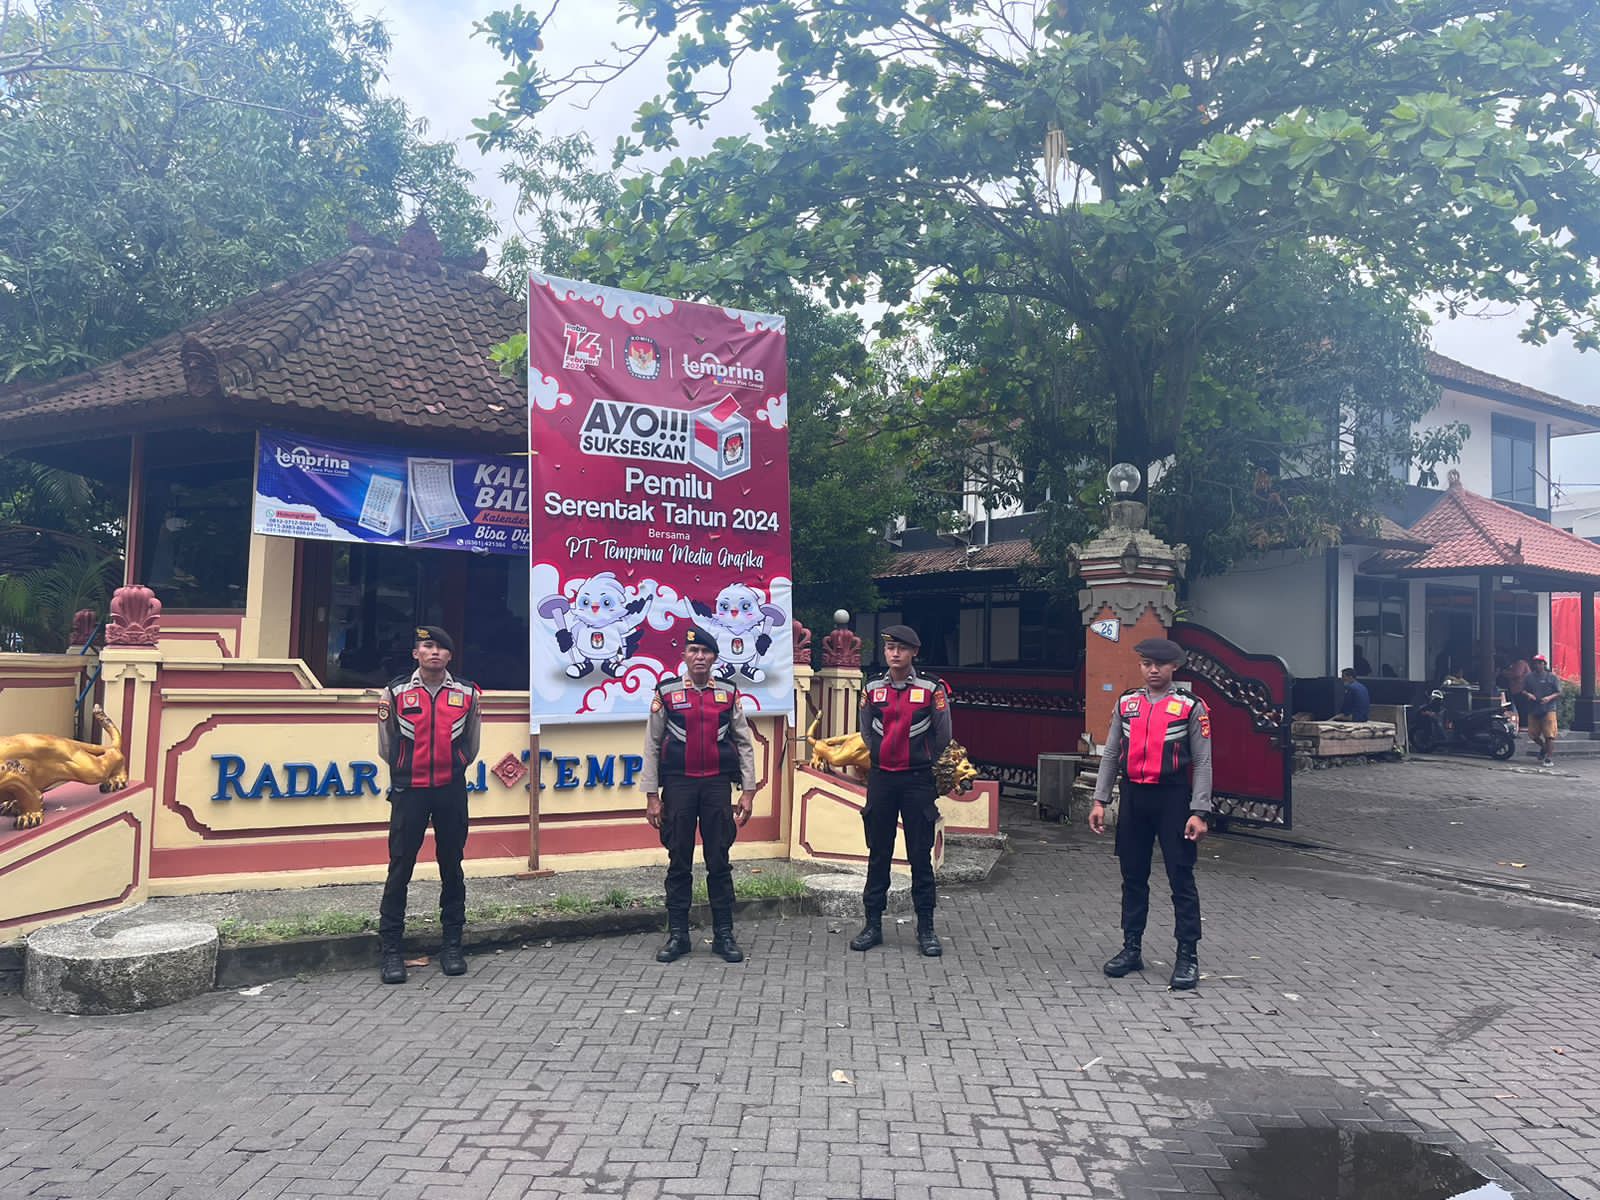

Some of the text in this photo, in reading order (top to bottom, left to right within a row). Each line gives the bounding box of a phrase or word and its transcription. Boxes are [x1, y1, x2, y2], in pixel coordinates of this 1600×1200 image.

[566, 331, 600, 358] 14
[584, 402, 688, 443] AYO!!!
[583, 435, 685, 461] SUKSESKAN
[626, 467, 712, 500] Pemilu
[544, 491, 779, 532] Serentak Tahun 2024
[475, 526, 507, 540] Bisa
[648, 528, 690, 540] Bersama
[565, 536, 764, 572] PT. Temprina Media Grafika
[1101, 623, 1113, 636] 26
[211, 754, 381, 801] RADAR
